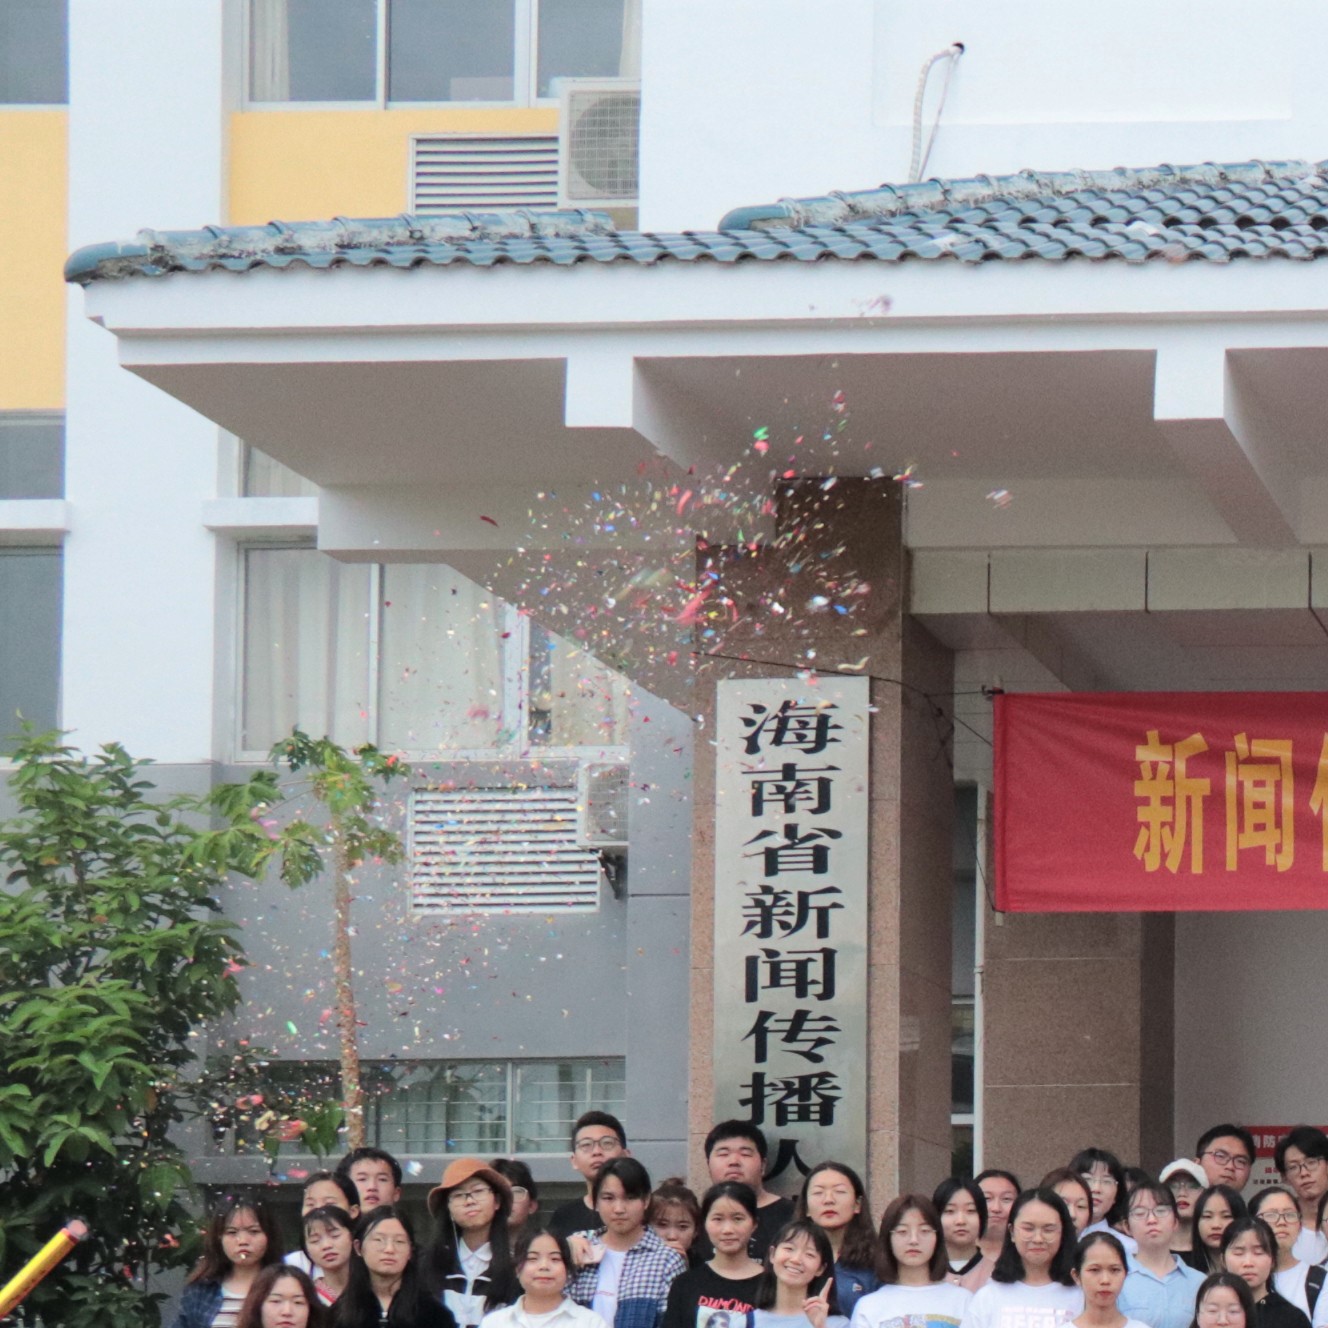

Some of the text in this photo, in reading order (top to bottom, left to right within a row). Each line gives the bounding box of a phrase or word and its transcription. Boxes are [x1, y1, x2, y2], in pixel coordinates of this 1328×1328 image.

[737, 700, 846, 1183] 海南省新闻传播人
